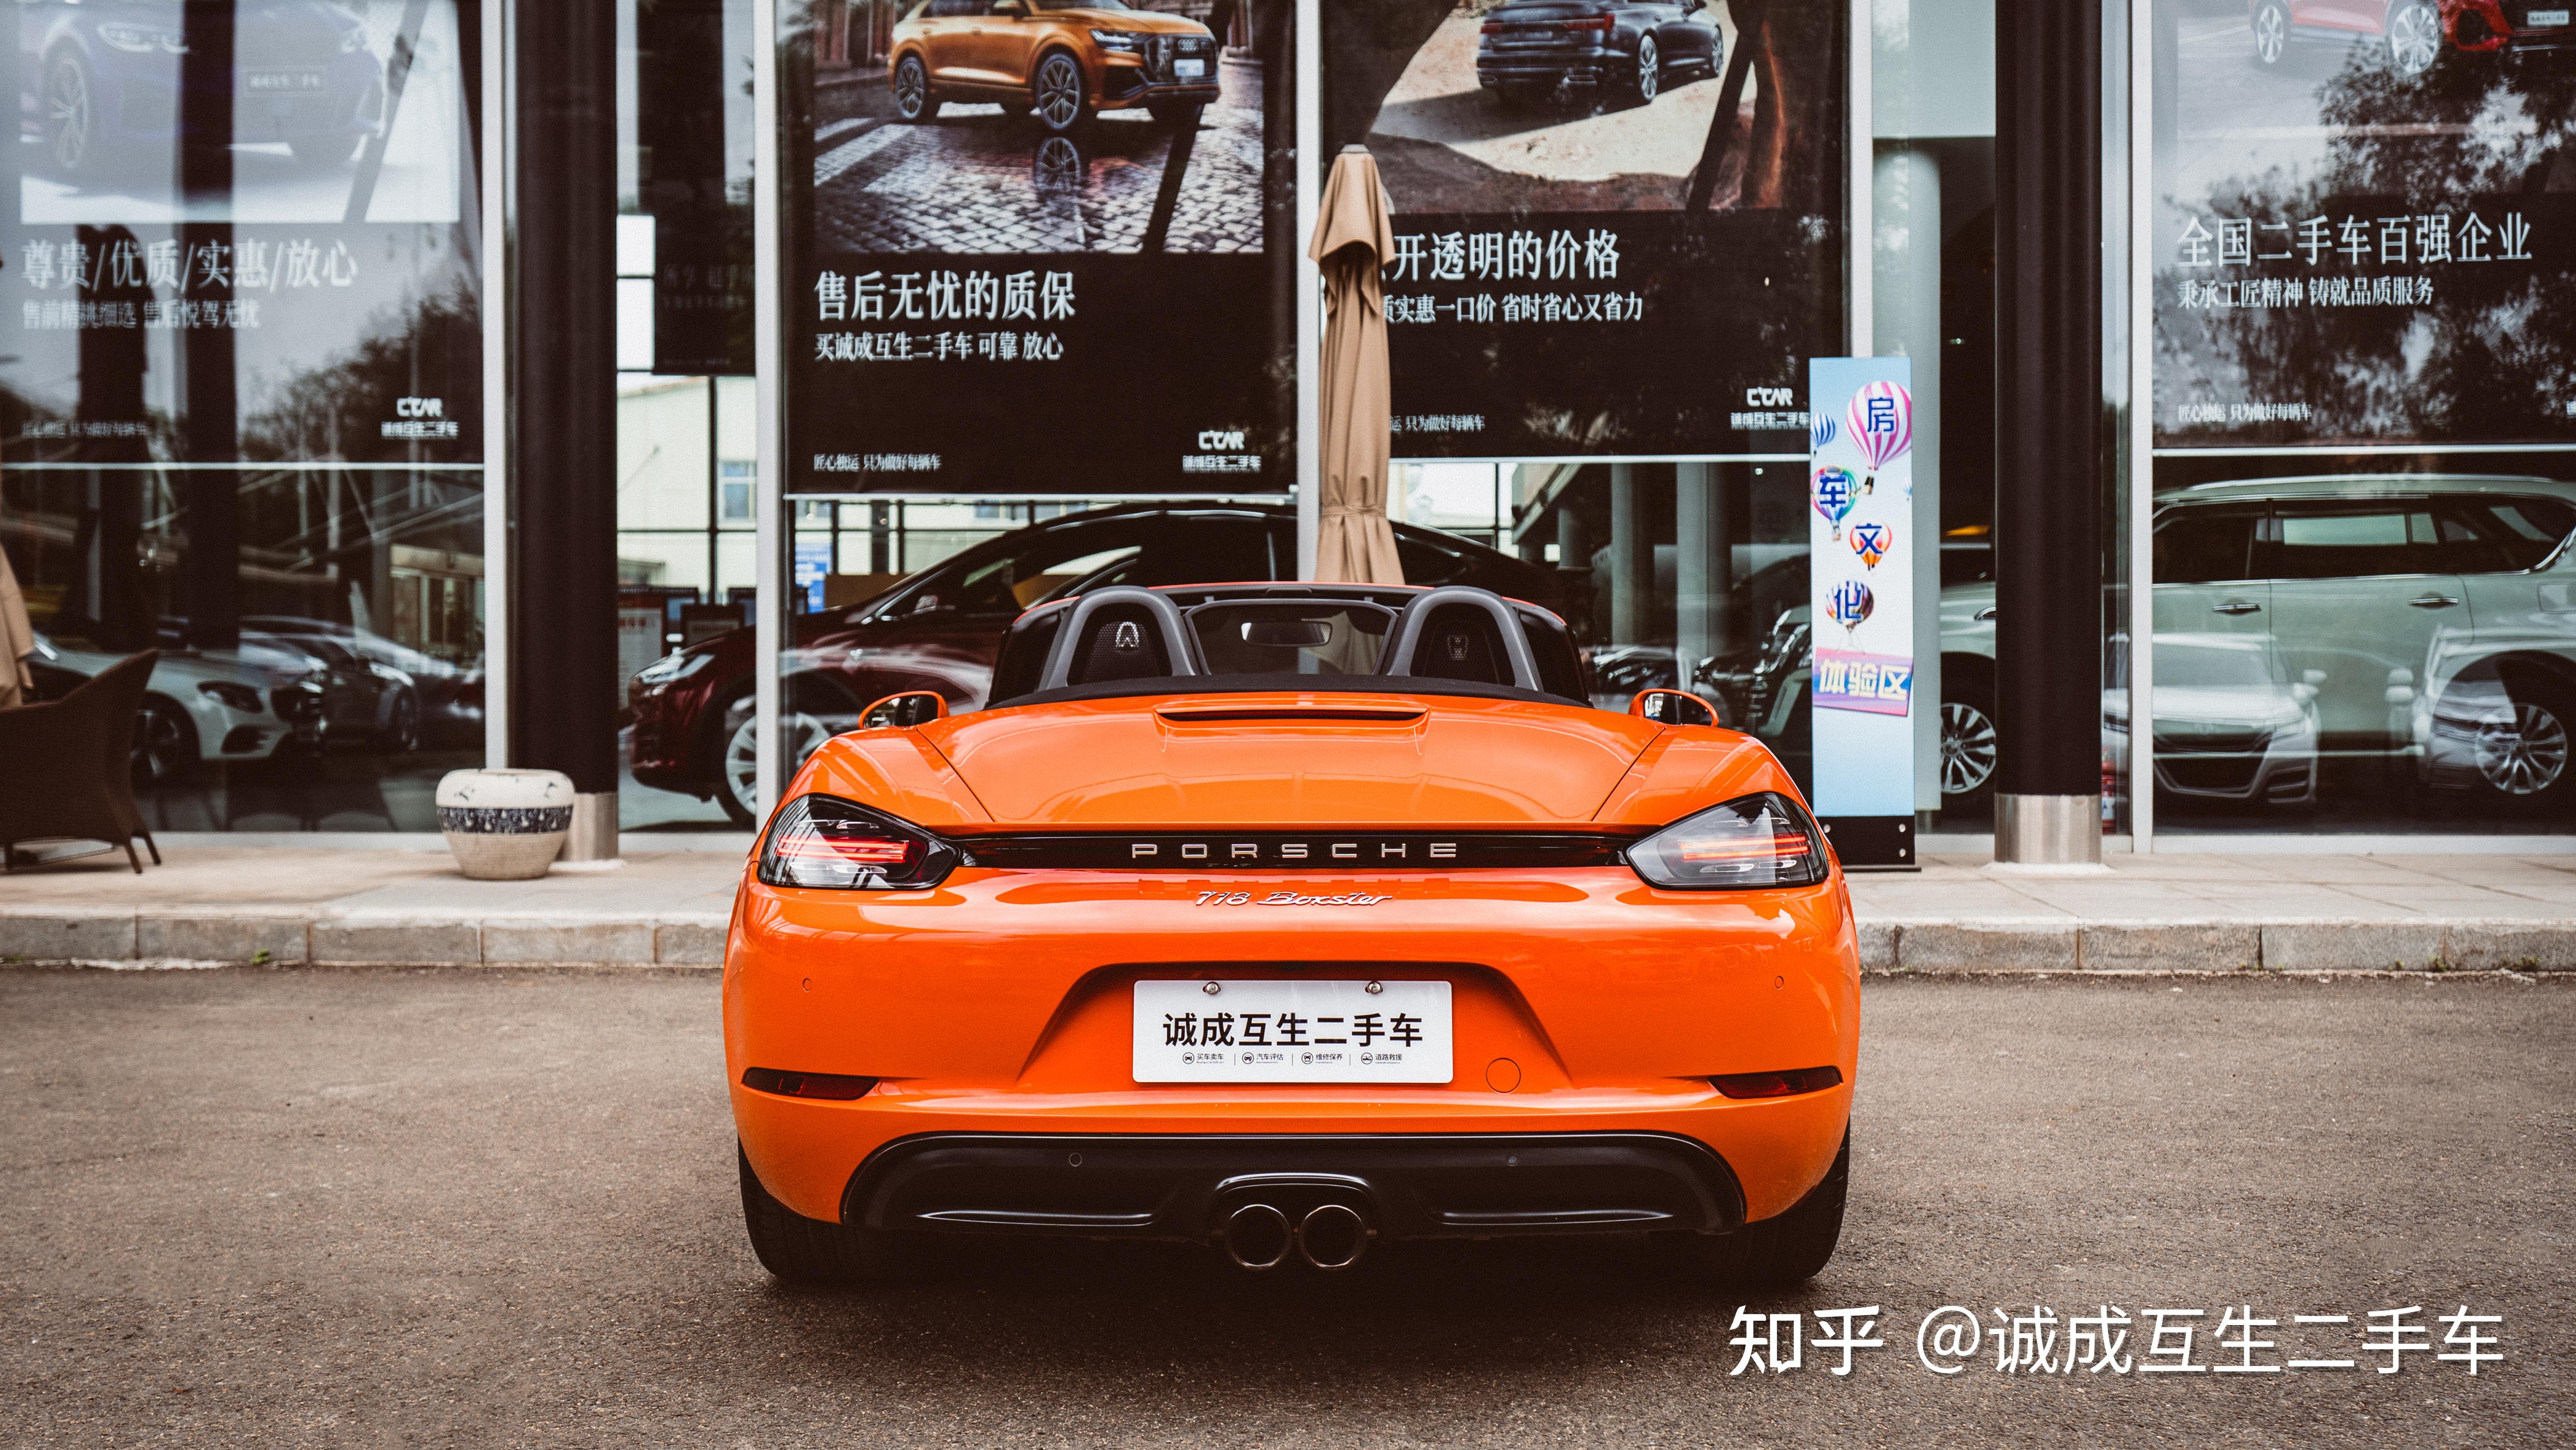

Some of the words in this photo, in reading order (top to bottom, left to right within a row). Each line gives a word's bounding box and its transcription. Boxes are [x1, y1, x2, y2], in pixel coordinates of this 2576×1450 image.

[1381, 229, 1621, 281] 开透明的价格
[2176, 212, 2532, 268] 全国二手车百强企业
[20, 238, 360, 293] 尊贵/优质/实惠/放心
[814, 270, 1076, 321] 售后无忧的质保
[1501, 291, 1643, 323] 省时省心又省力
[2177, 278, 2304, 309] 秉承工匠精神
[2308, 275, 2435, 307] 铸就品质服务
[815, 331, 974, 362] 买诚成互生二手车
[978, 331, 1019, 362] 可靠
[1022, 331, 1064, 361] 放心
[1867, 397, 1895, 433] 房
[1819, 477, 1846, 507] 车
[1855, 523, 1883, 555] 文
[1833, 589, 1862, 620] 化
[1819, 658, 1910, 701] 体验区
[1132, 843, 1457, 859] PORSCHE
[1196, 891, 1251, 905] 718
[1257, 891, 1393, 906] Boxster
[1163, 1013, 1423, 1048] 诚成互生二手车
